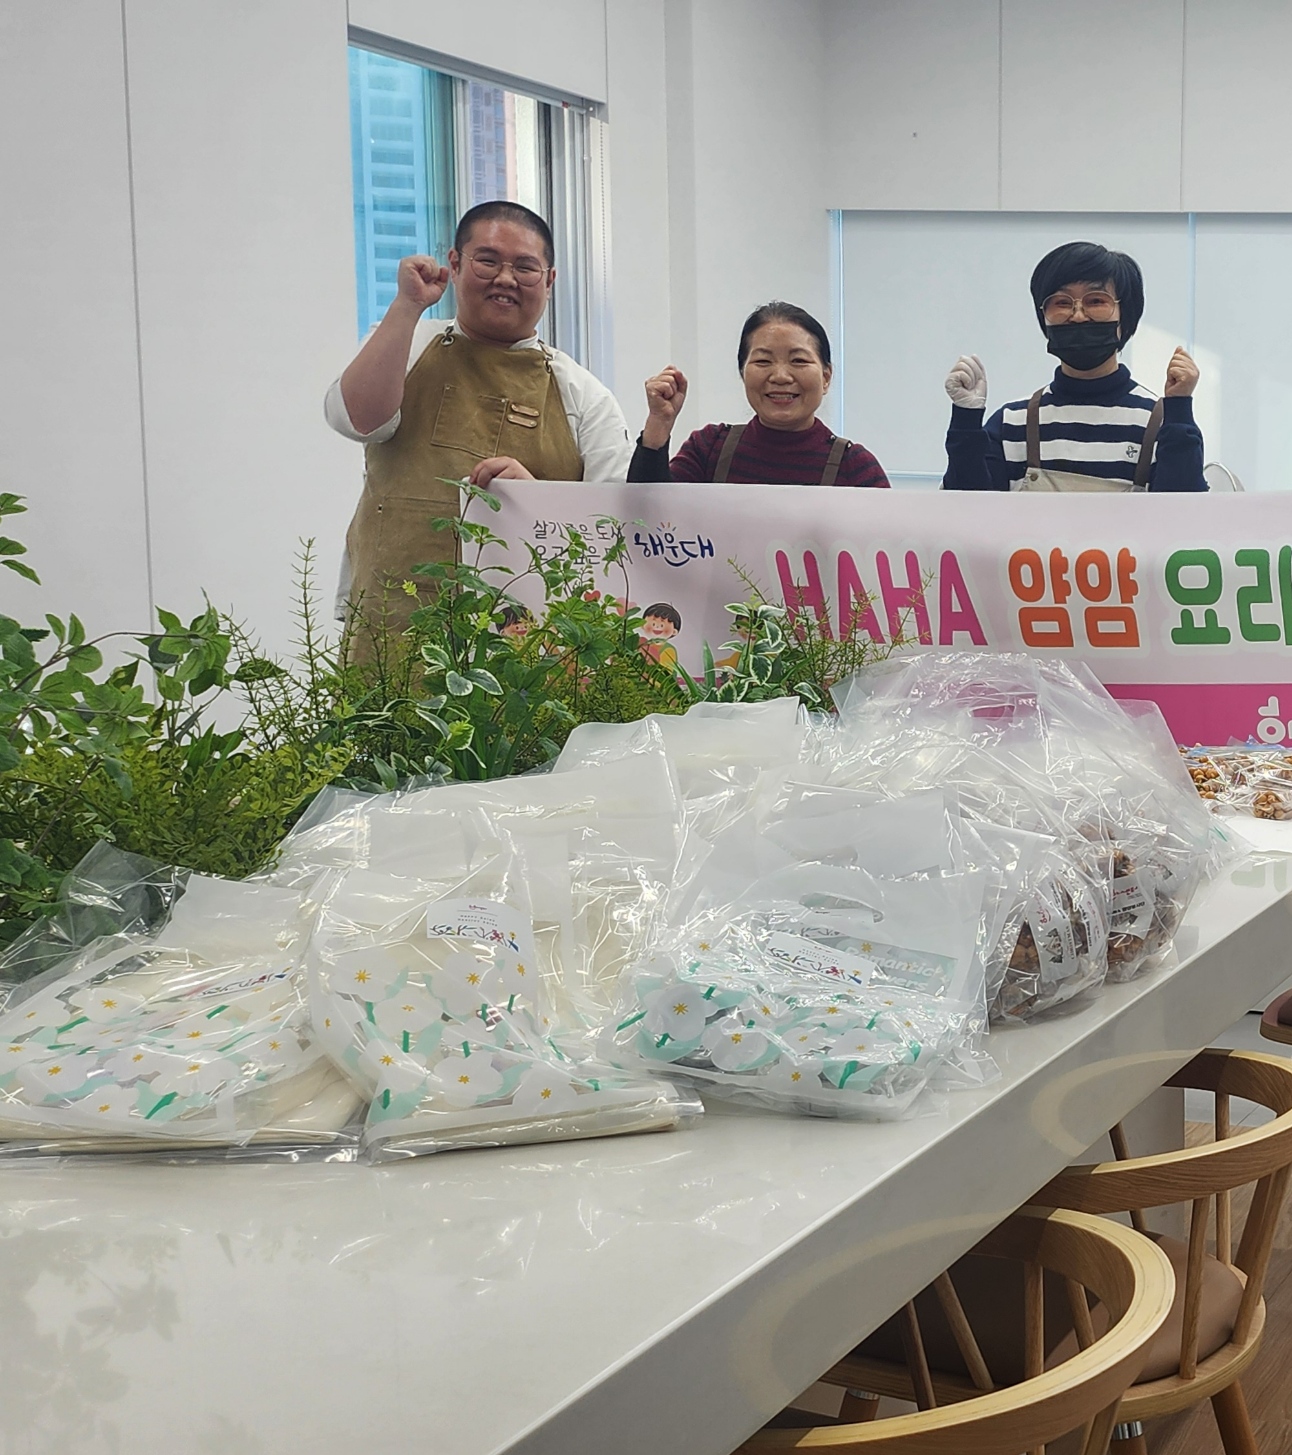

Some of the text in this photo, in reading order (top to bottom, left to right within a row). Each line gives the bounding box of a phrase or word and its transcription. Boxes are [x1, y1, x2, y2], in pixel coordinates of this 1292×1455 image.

[634, 532, 715, 567] 해운대
[775, 549, 989, 646] HAHA
[1008, 547, 1141, 647] 얌얌
